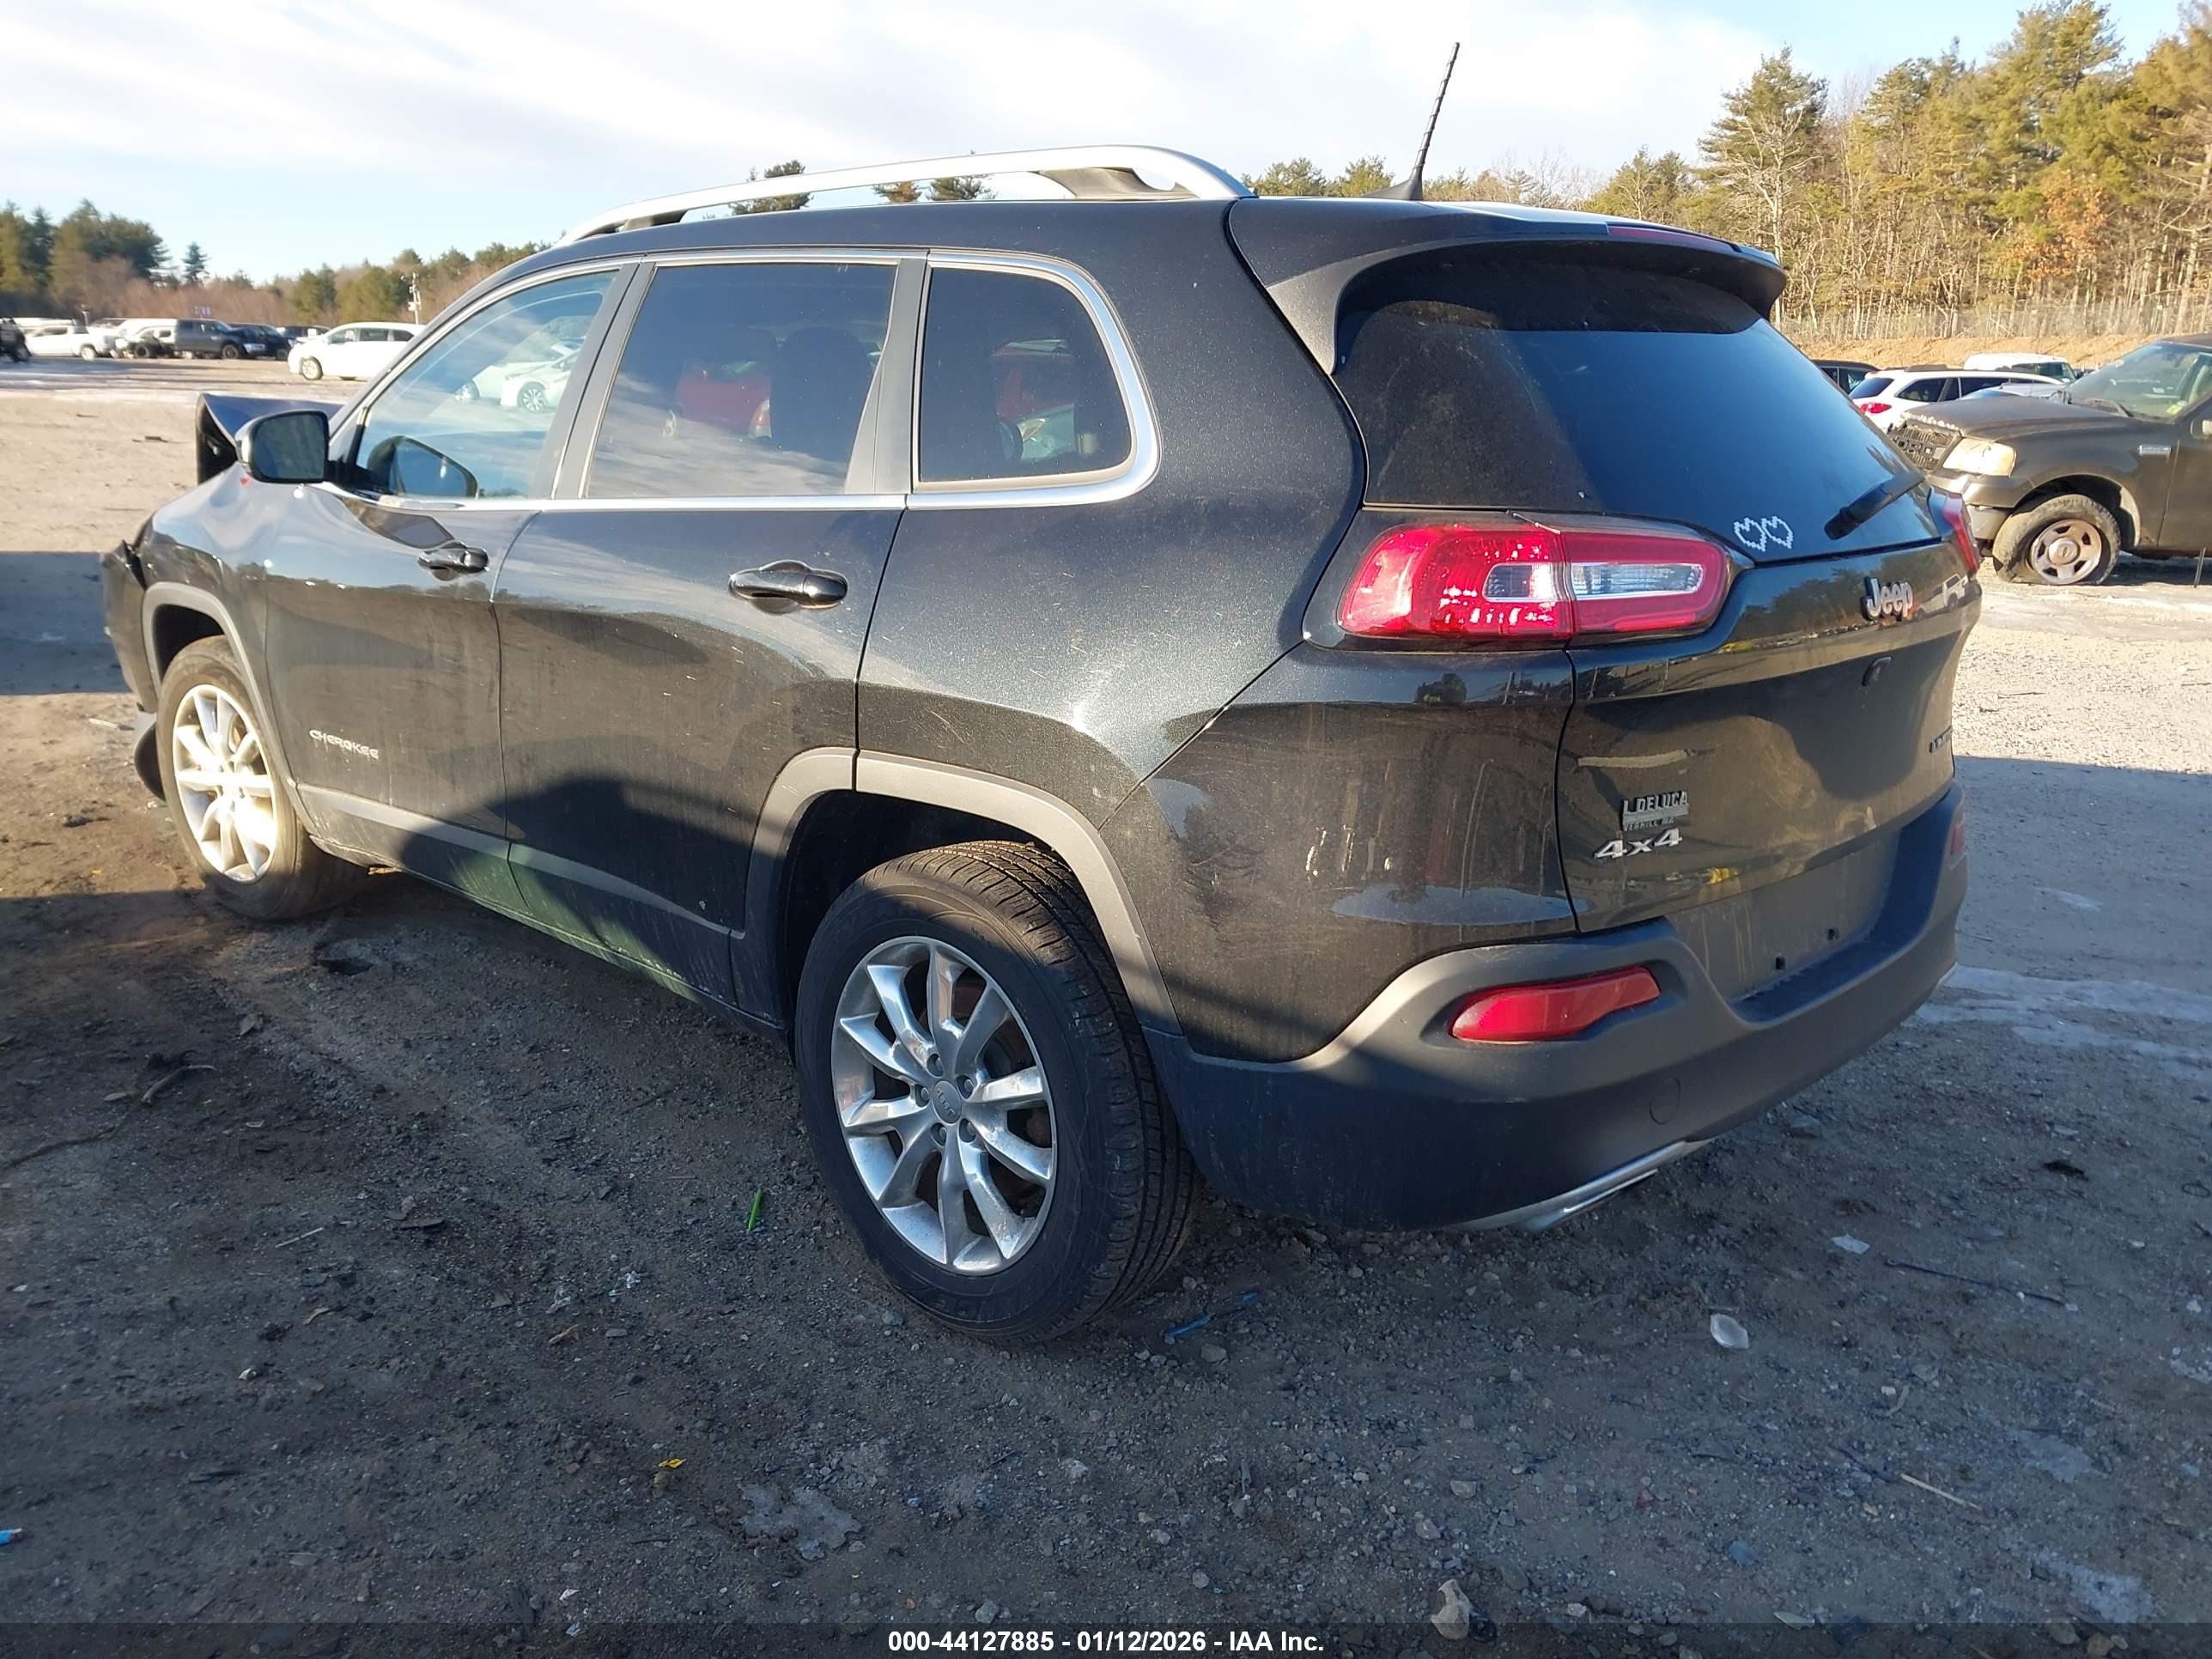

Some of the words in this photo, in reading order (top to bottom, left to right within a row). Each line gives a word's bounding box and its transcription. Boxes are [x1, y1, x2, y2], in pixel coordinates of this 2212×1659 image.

[1863, 577, 1913, 619] Jeep
[308, 729, 380, 760] CHEROKEE
[1594, 828, 1682, 859] 4x4
